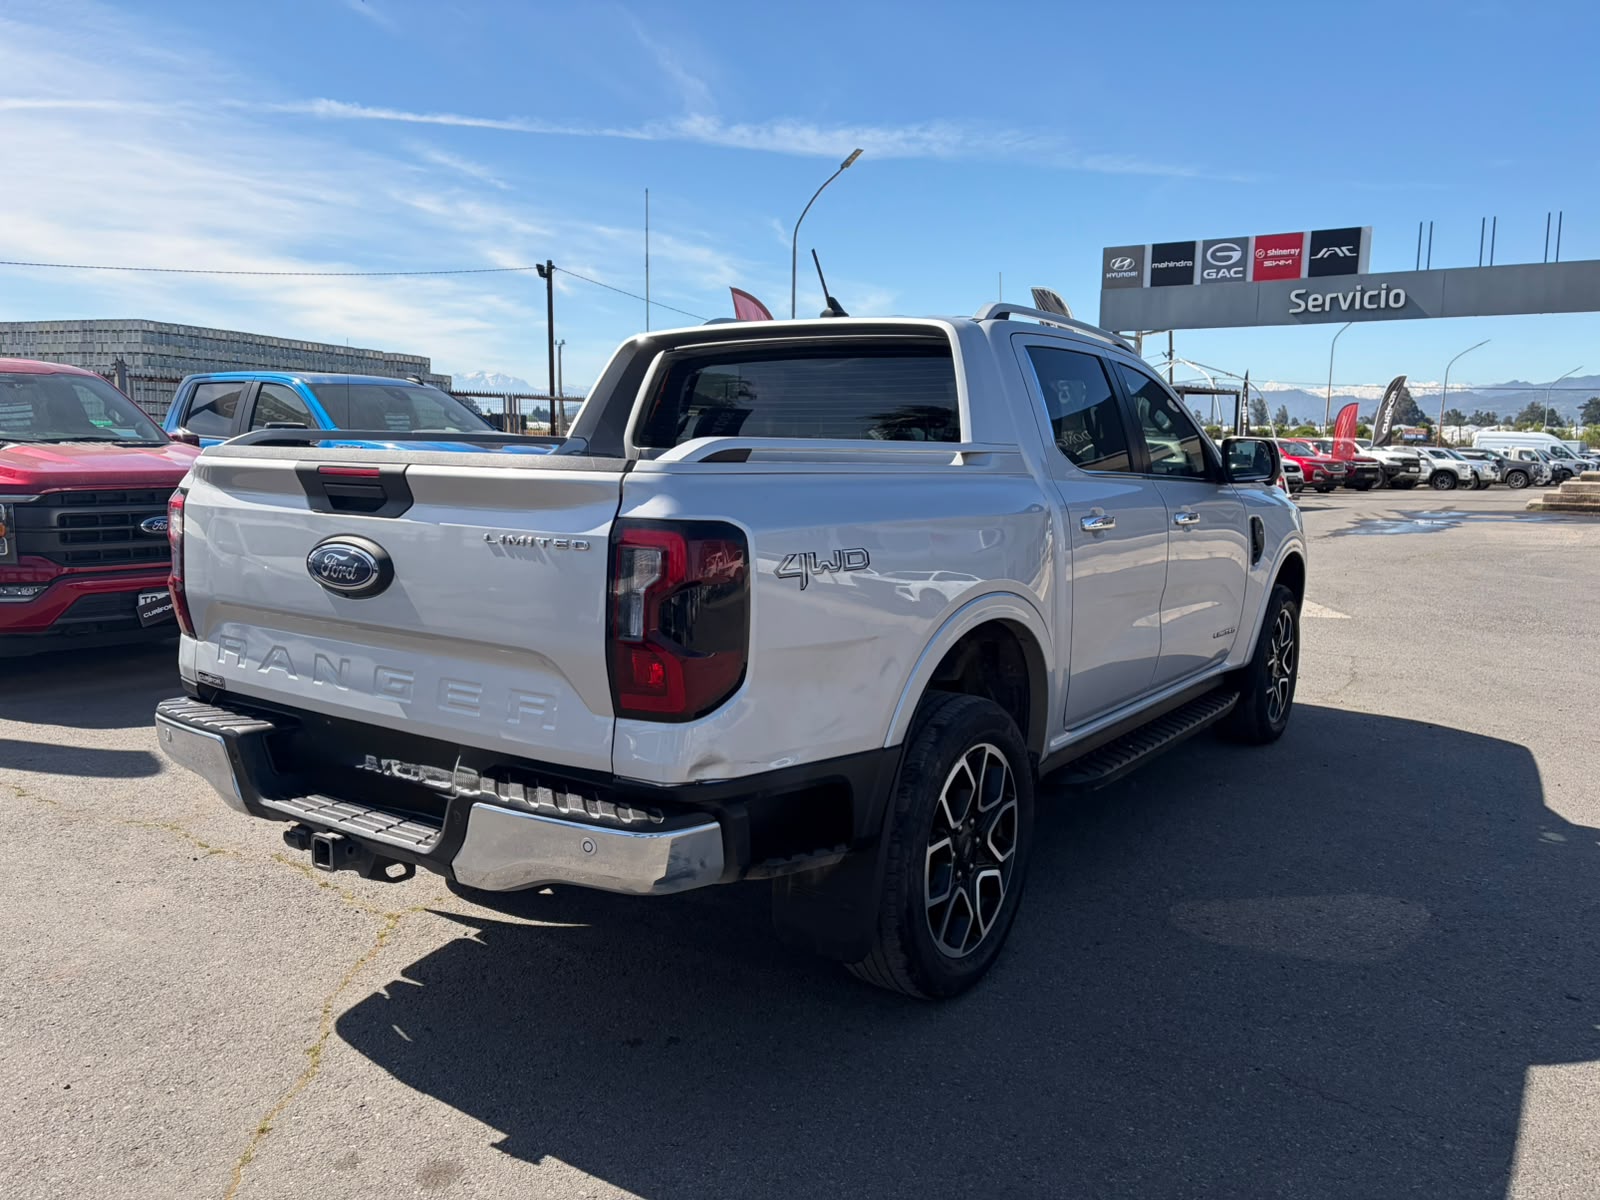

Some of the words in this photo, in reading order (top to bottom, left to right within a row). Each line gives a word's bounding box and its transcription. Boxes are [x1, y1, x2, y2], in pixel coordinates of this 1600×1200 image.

[1310, 246, 1357, 260] JAC
[1152, 260, 1193, 269] mahindra
[1263, 259, 1292, 267] SWM
[1106, 271, 1138, 279] HYUNDAI
[1203, 267, 1243, 279] GAC
[1289, 283, 1406, 314] Servicio
[483, 533, 590, 551] LIMITED
[321, 552, 358, 580] Ford
[773, 547, 871, 591] 4WD
[217, 634, 559, 730] RANGER
